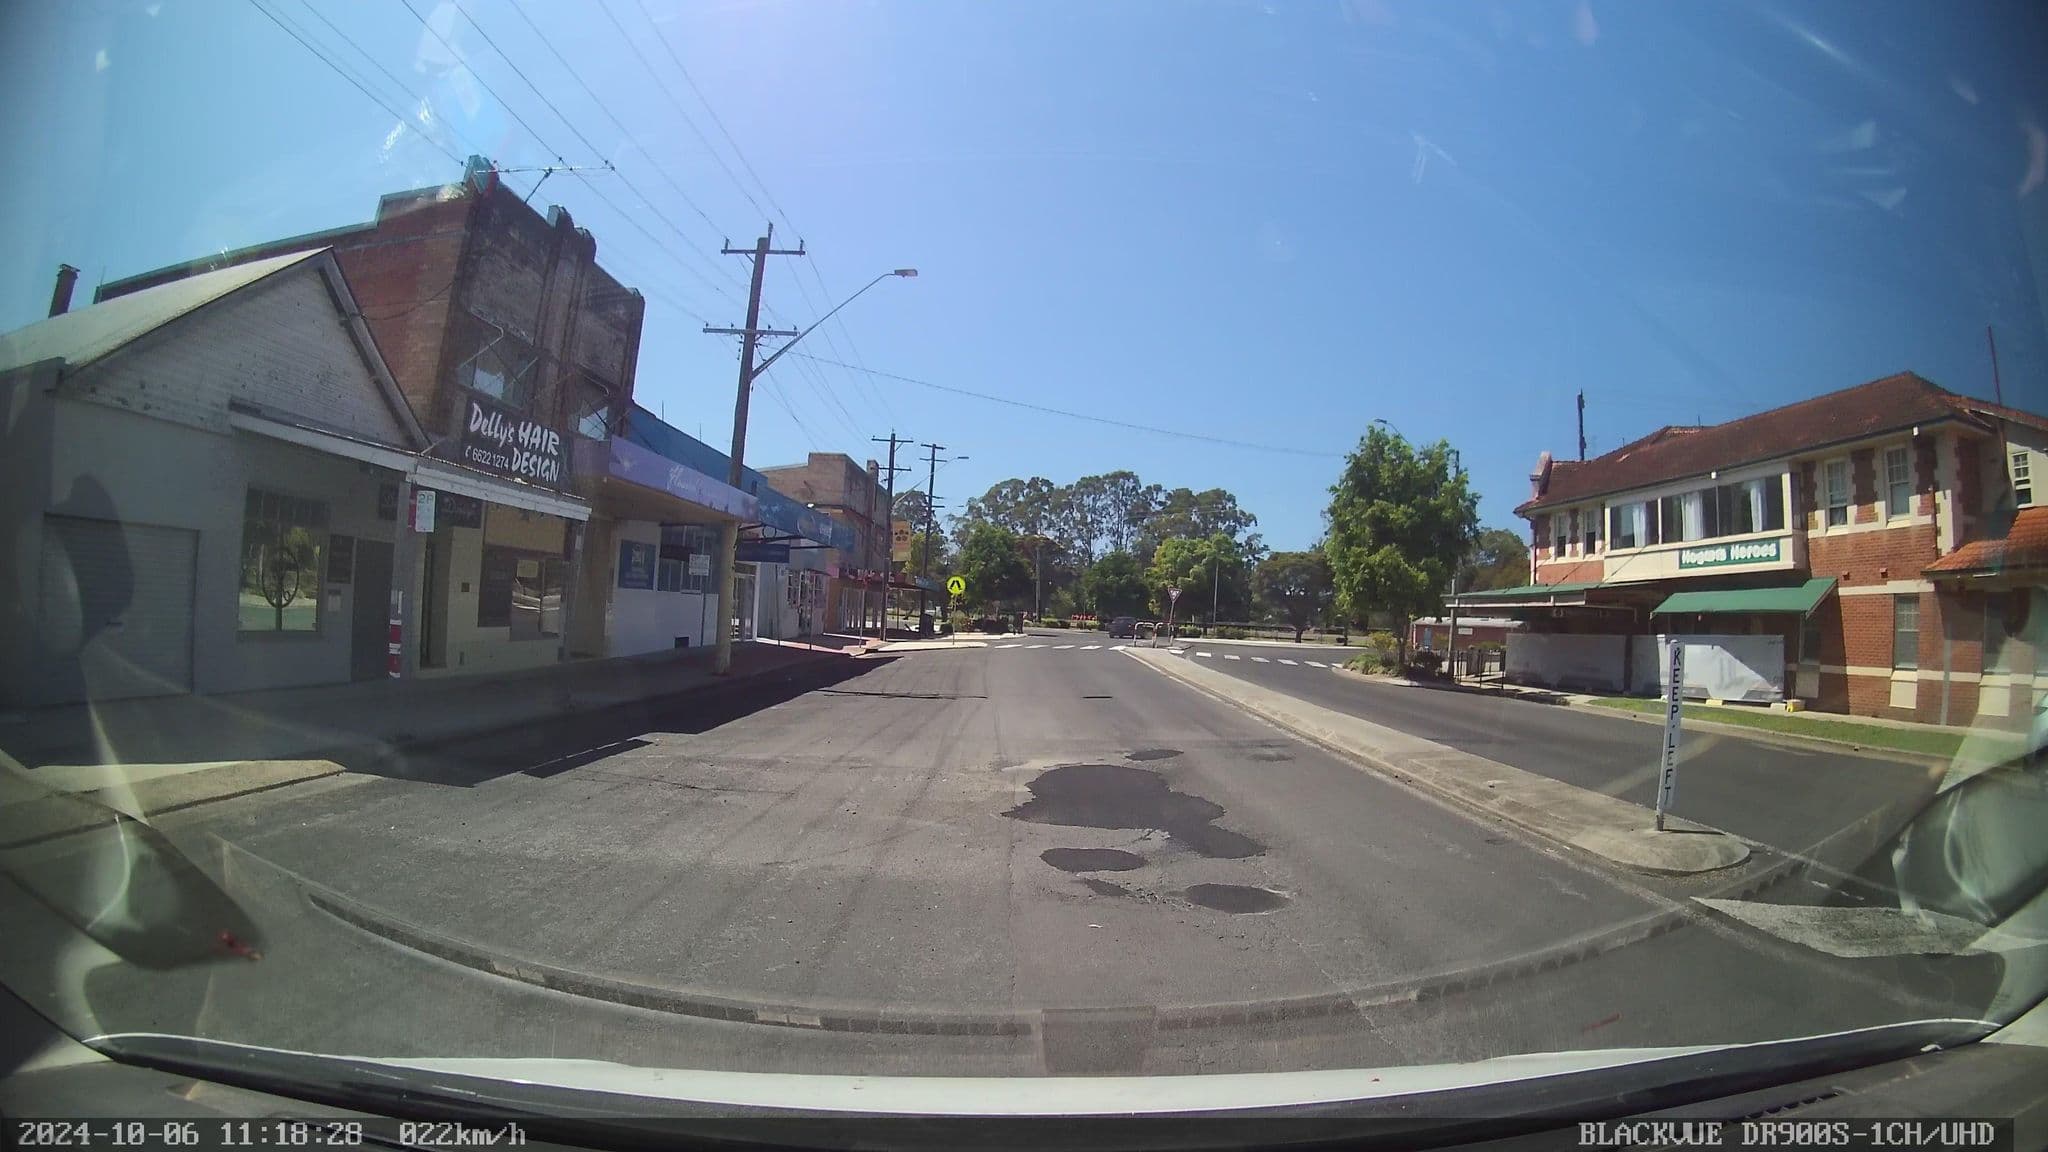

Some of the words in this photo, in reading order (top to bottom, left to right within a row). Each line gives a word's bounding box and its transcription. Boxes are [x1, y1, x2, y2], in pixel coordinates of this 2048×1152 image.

[469, 402, 515, 448] Delly's
[518, 421, 560, 456] HAIR
[511, 447, 560, 482] DESIGN
[1730, 543, 1777, 560] Heroes
[1670, 649, 1681, 721] KEEP
[1664, 732, 1676, 806] LEFT
